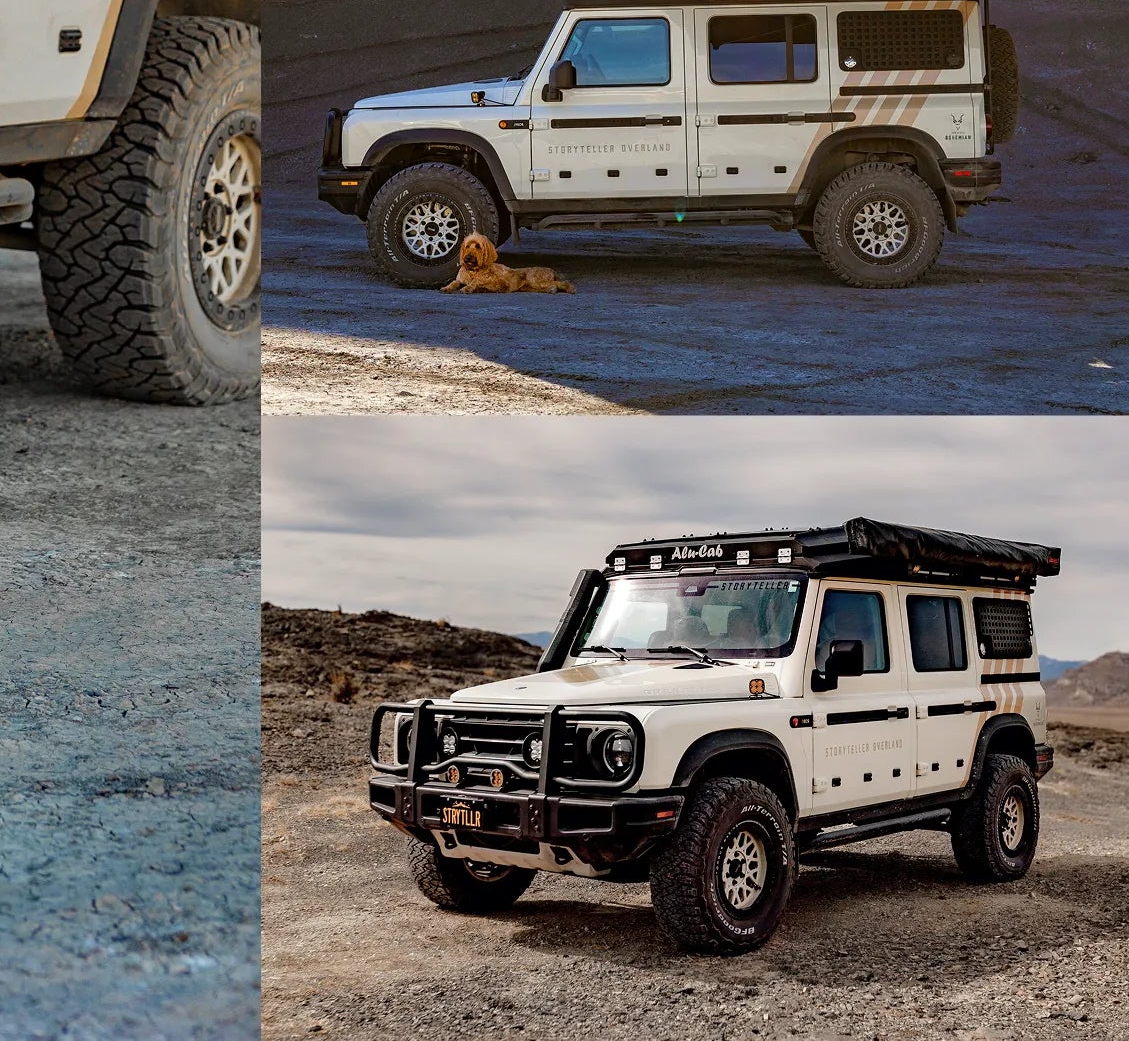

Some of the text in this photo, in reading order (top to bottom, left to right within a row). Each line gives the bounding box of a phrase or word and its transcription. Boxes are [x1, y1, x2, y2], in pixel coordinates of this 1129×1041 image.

[548, 143, 671, 154] STORYTELLER OVERLAND
[671, 544, 723, 560] Alu-Cab
[720, 581, 789, 591] STORYTELLER
[825, 738, 903, 758] STORYTELLER OVERLAND
[442, 807, 481, 828] STRYTLLR
[741, 804, 784, 841] All-Terrain
